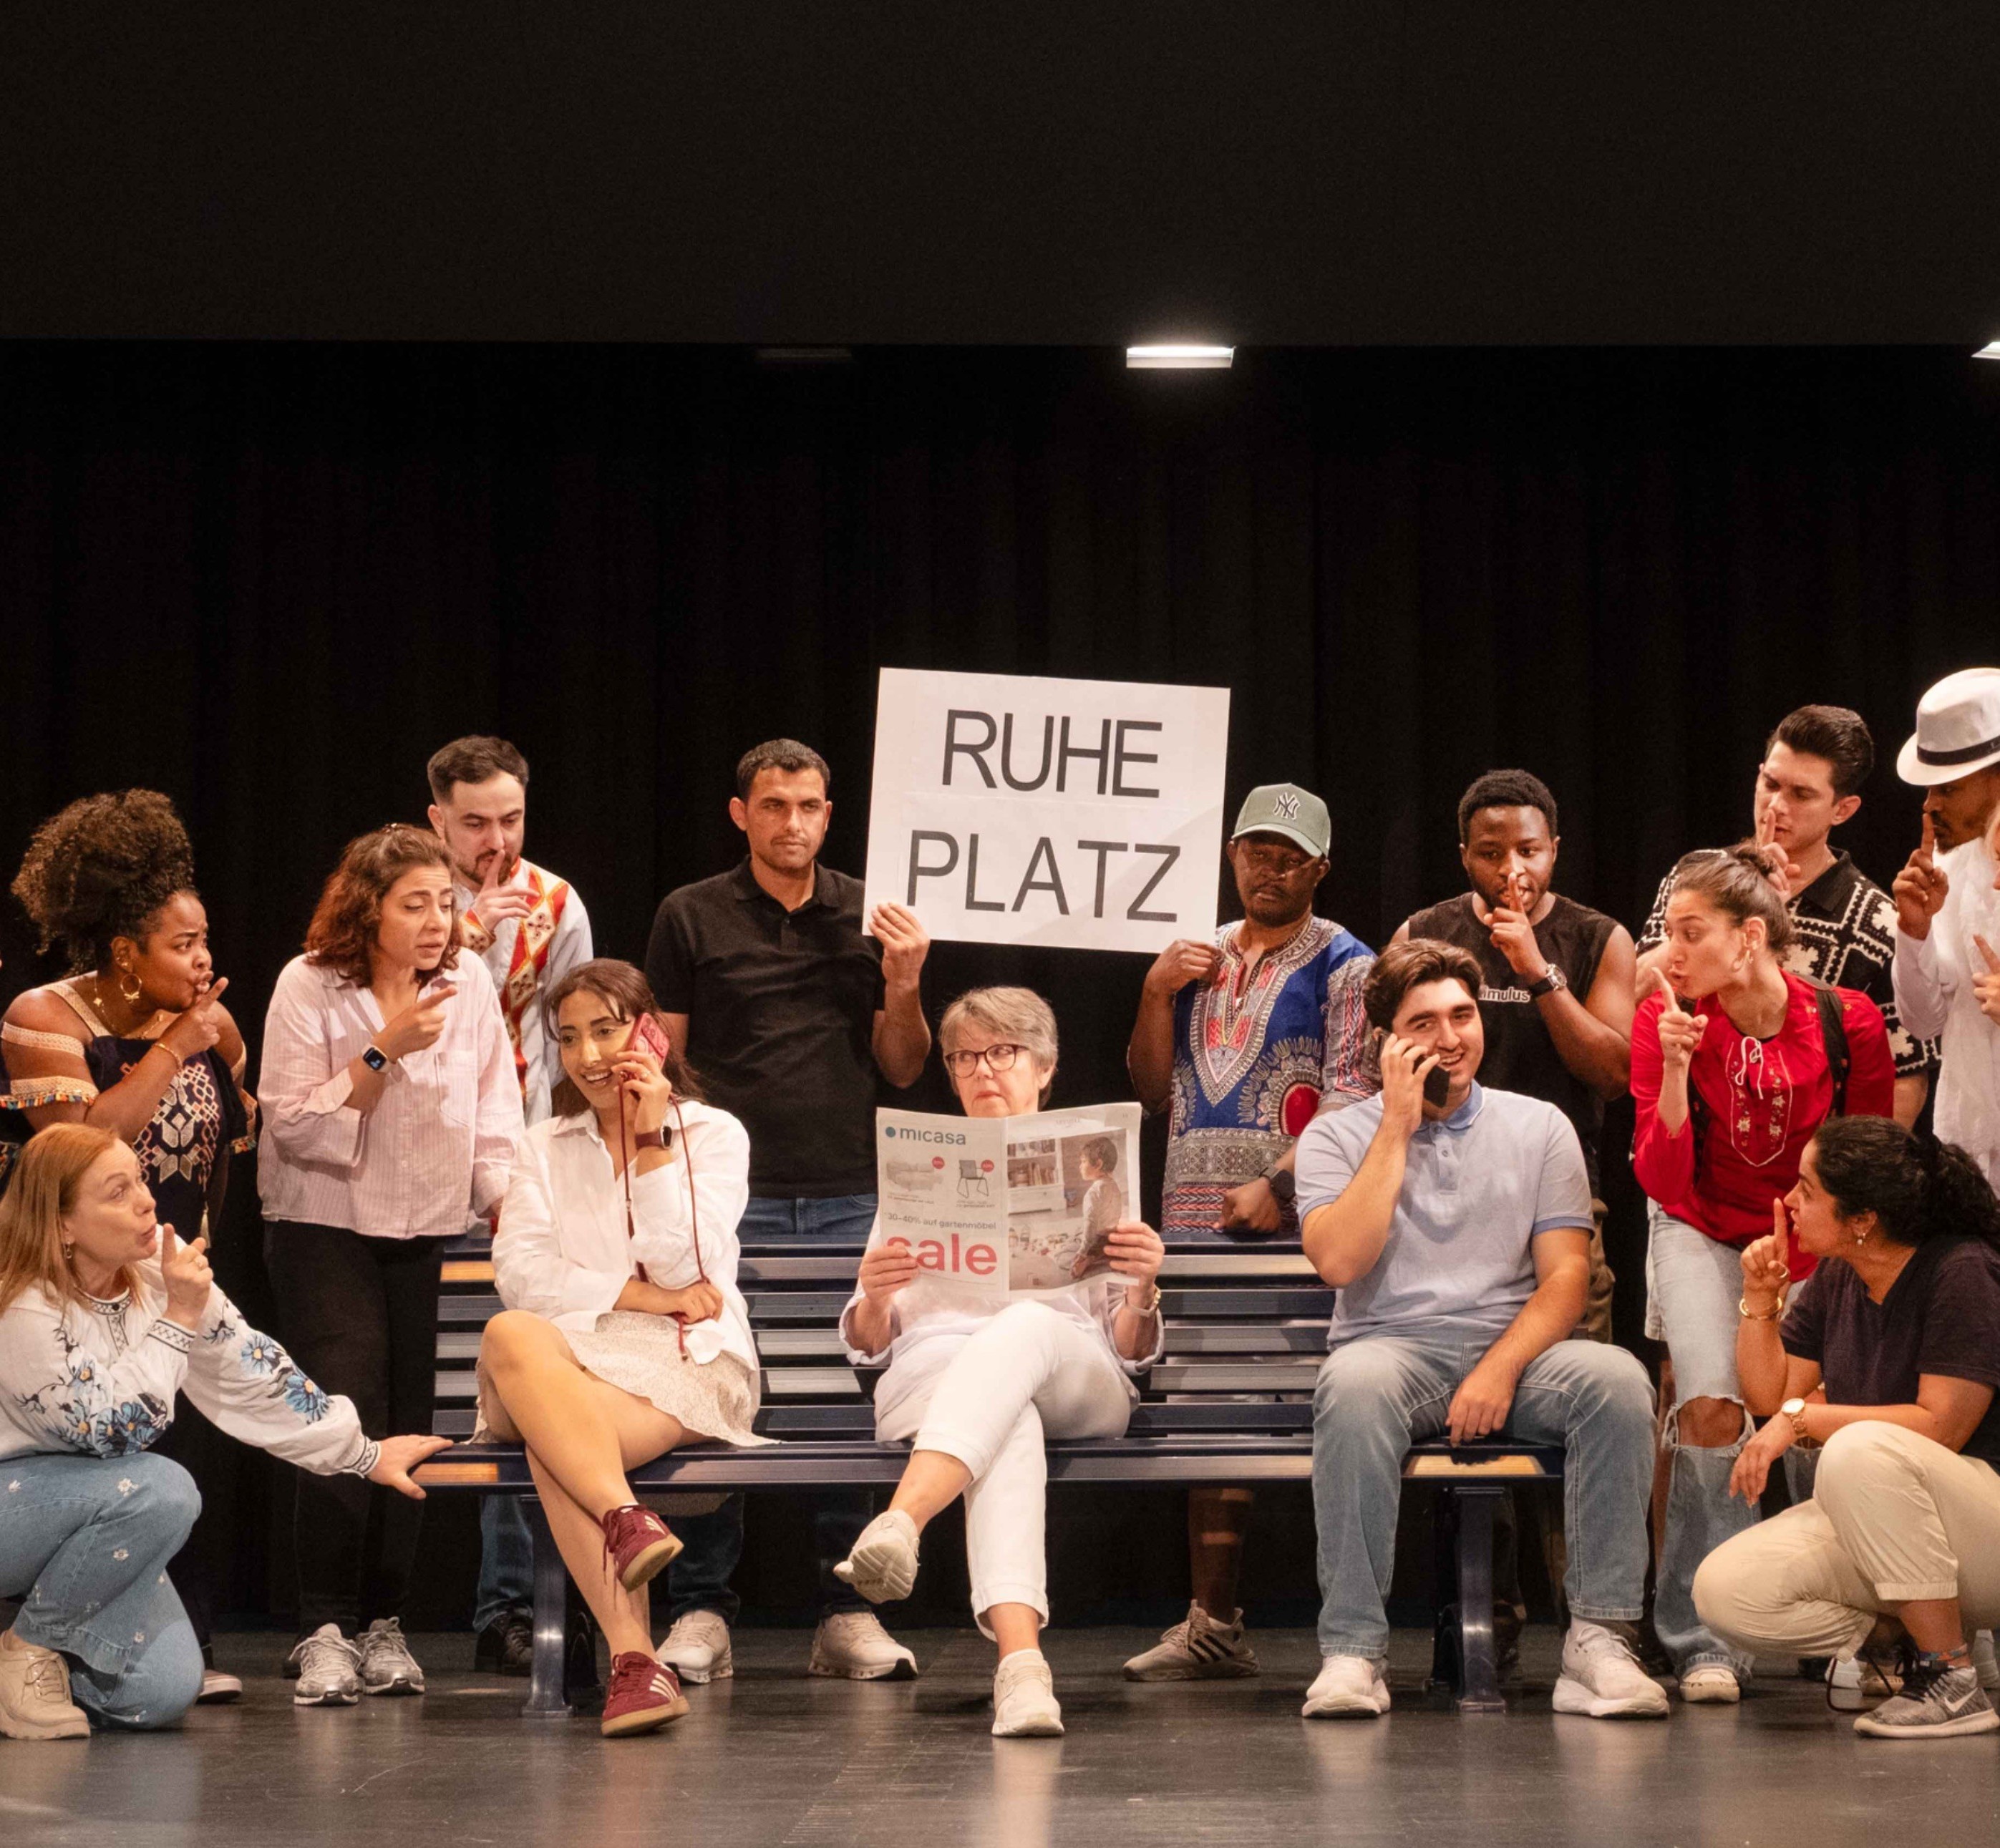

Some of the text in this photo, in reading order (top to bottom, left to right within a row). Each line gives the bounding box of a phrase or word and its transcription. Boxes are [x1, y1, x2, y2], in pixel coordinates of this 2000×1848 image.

[942, 709, 1162, 798] RUHE
[906, 830, 1181, 923] PLATZ
[900, 1127, 966, 1145] micasa
[938, 1219, 997, 1230] gartenmöbel
